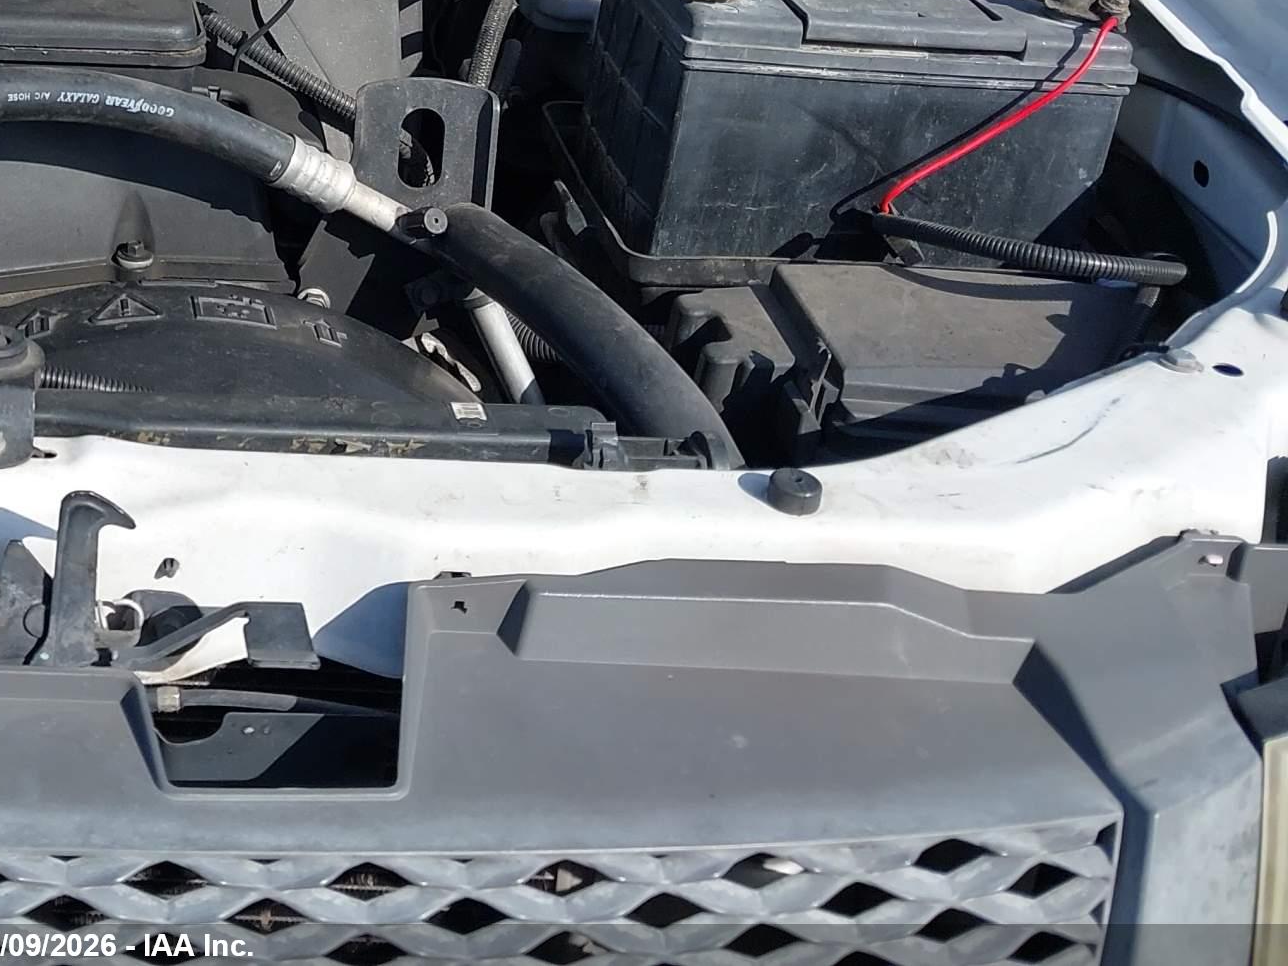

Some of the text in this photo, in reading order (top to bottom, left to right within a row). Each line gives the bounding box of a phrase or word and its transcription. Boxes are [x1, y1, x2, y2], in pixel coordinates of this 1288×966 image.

[7, 92, 31, 102] HOSE
[34, 91, 51, 101] A/C
[56, 91, 100, 104] GALAXY
[105, 95, 175, 117] GOODYEAR
